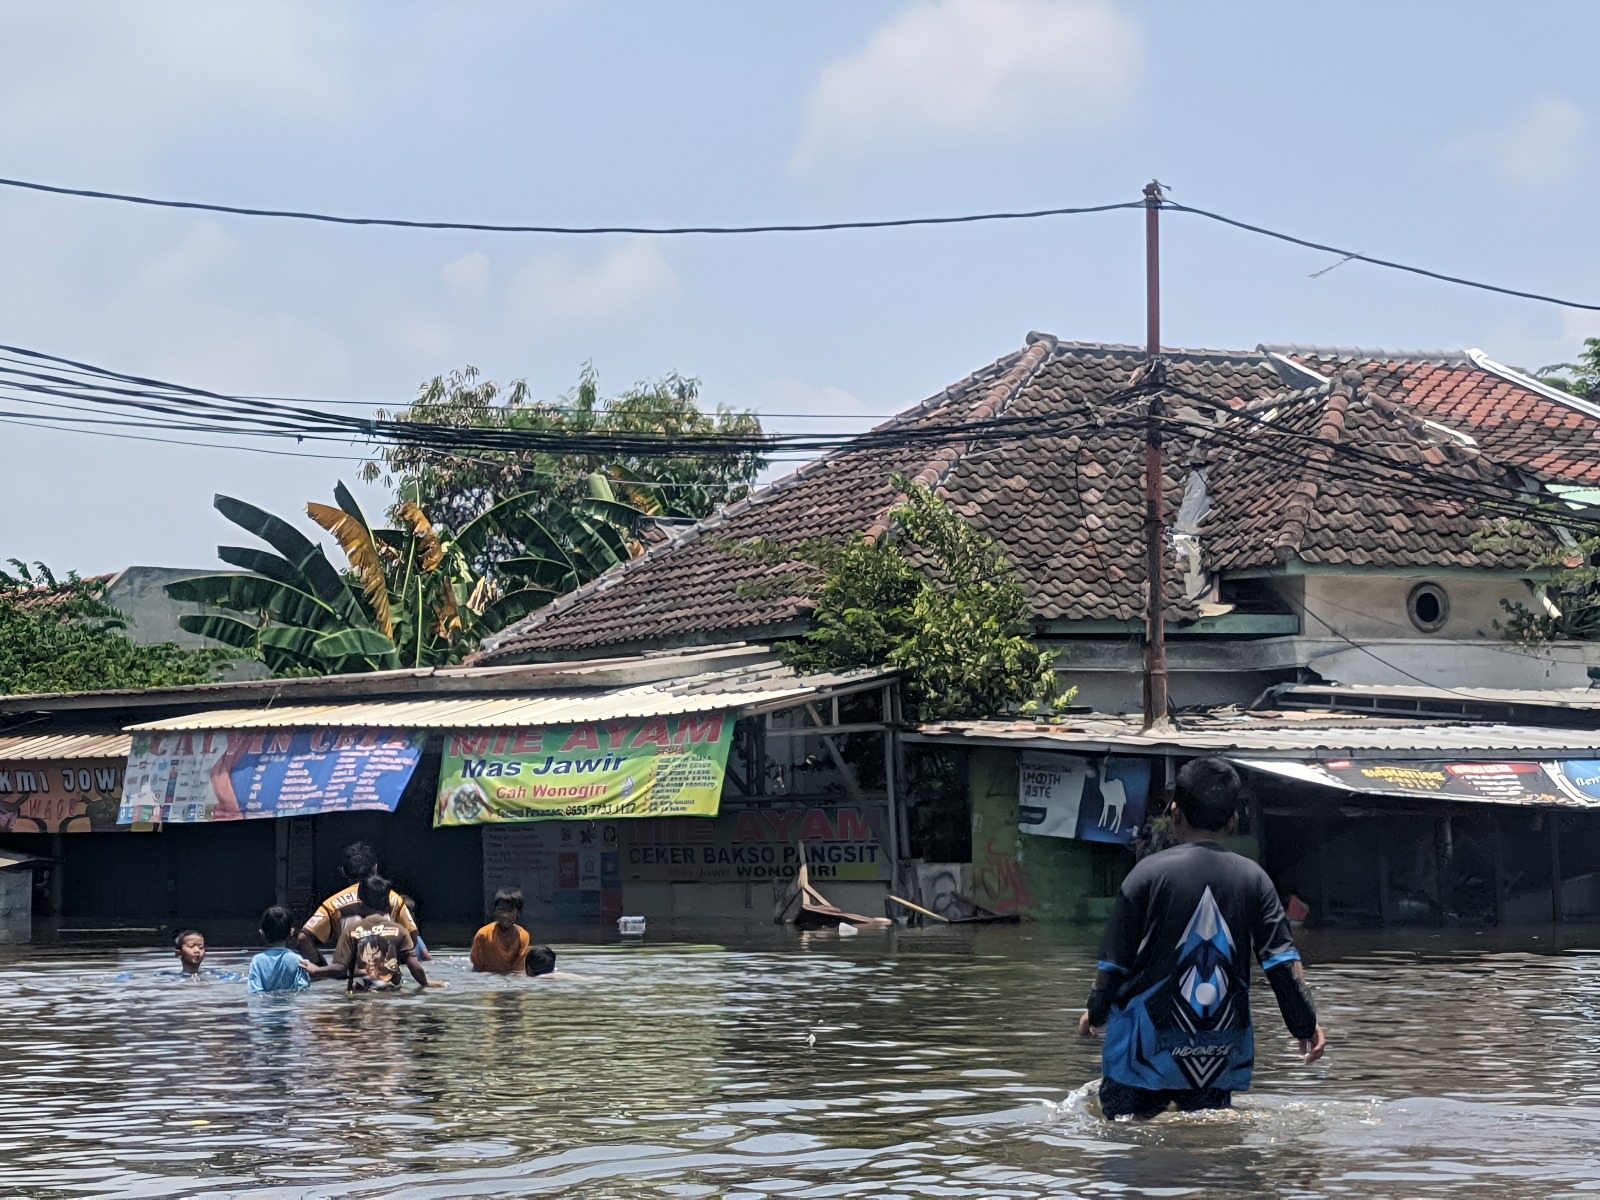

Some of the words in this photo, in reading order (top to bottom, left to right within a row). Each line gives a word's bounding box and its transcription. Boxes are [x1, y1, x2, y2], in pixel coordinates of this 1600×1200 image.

[149, 728, 293, 756] CALVIN
[450, 728, 544, 758] MIE
[559, 714, 726, 752] AYAM
[461, 758, 521, 778] Mas
[533, 754, 628, 776] Jawir
[61, 767, 127, 793] JOW
[496, 785, 527, 799] Cah
[533, 783, 608, 799] Wonogiri
[1023, 785, 1052, 798] ASTE
[731, 808, 882, 844] AYAM
[629, 846, 696, 865] CEKER
[703, 846, 775, 865] BAKSO
[783, 844, 880, 864] PANGSIT
[737, 865, 837, 878] WONOIRI
